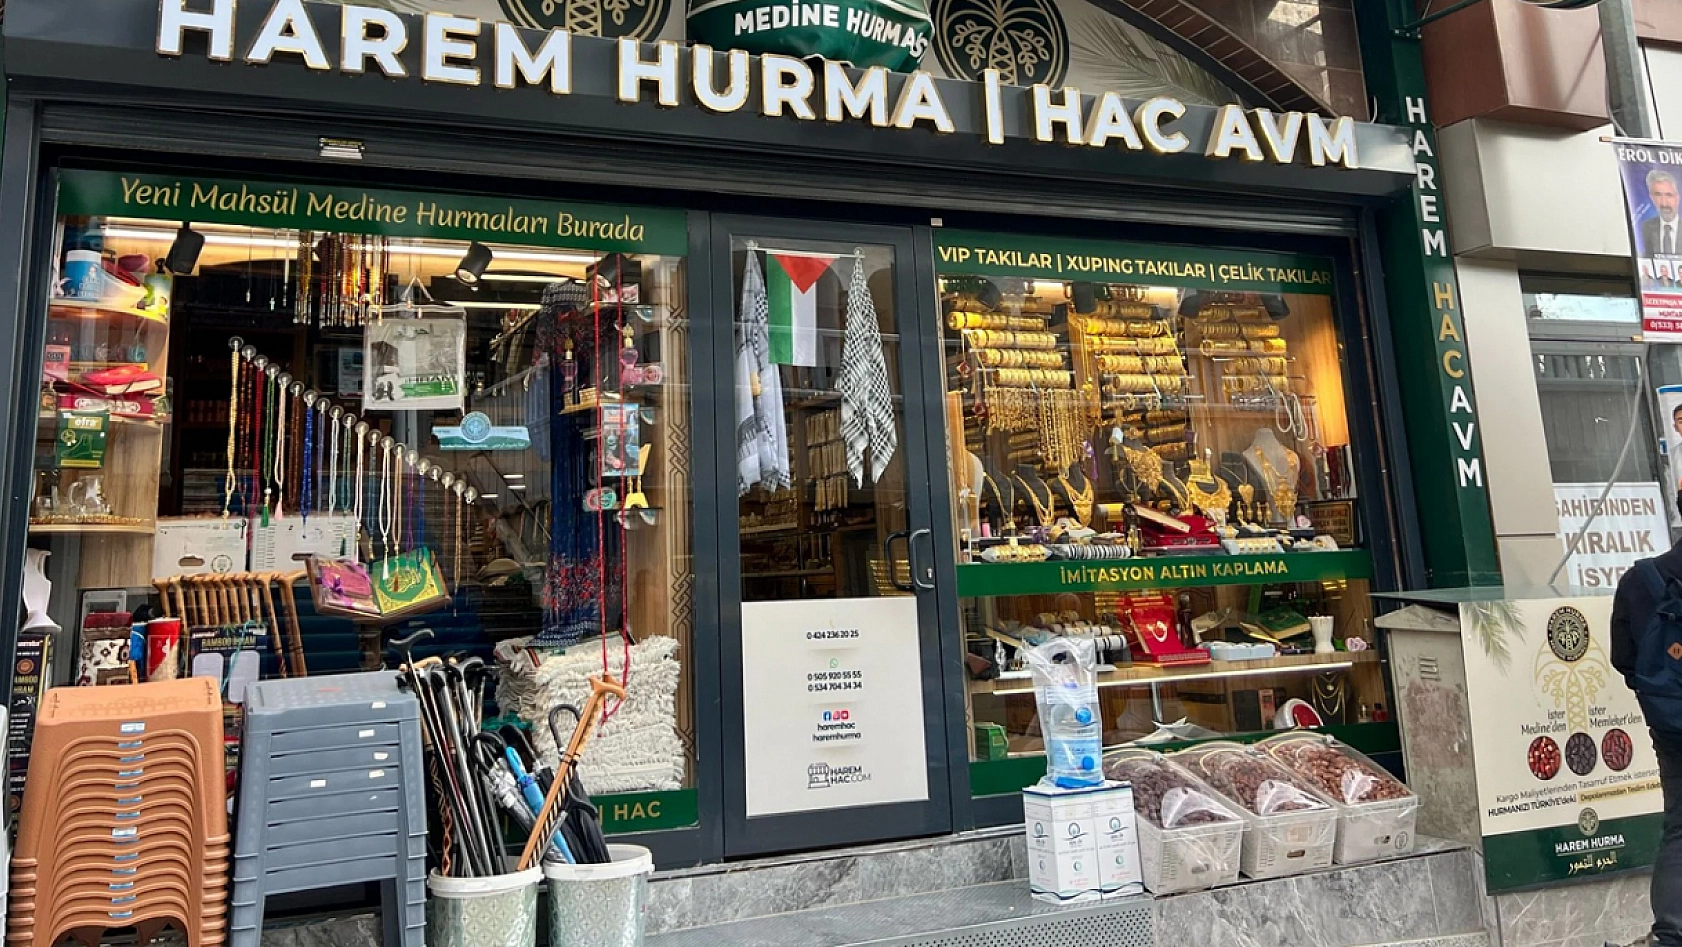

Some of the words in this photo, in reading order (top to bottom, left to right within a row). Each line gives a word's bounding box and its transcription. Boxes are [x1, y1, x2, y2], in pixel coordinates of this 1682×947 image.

[734, 0, 840, 36] MEDİNE
[156, 0, 572, 94] HAREM
[618, 36, 955, 132] HURMA
[1031, 84, 1189, 153] HAC
[1206, 104, 1359, 169] AVM
[1618, 147, 1656, 164] EROL
[121, 178, 180, 206] Yeni
[190, 183, 297, 216] Mahsül
[306, 191, 407, 223] Medine
[416, 201, 548, 235] Hurmaları
[557, 211, 645, 242] Burada
[938, 246, 971, 263] VIP
[974, 249, 1052, 269] TAKILAR
[1066, 254, 1133, 275] XUPING
[1135, 259, 1206, 279] TAKILAR
[1218, 262, 1265, 284] ÇELİK
[1267, 267, 1332, 285] TAKILAR
[1405, 96, 1447, 257] HAREM
[1432, 281, 1465, 378] HAC
[1450, 386, 1483, 487] AVM
[1060, 565, 1154, 585] İMİTASYON
[1160, 563, 1207, 580] ALTIN
[1212, 559, 1289, 578] KAPLAMA
[614, 801, 661, 821] HAC
[1555, 839, 1589, 853] HAREM
[1590, 834, 1625, 848] HURMA
